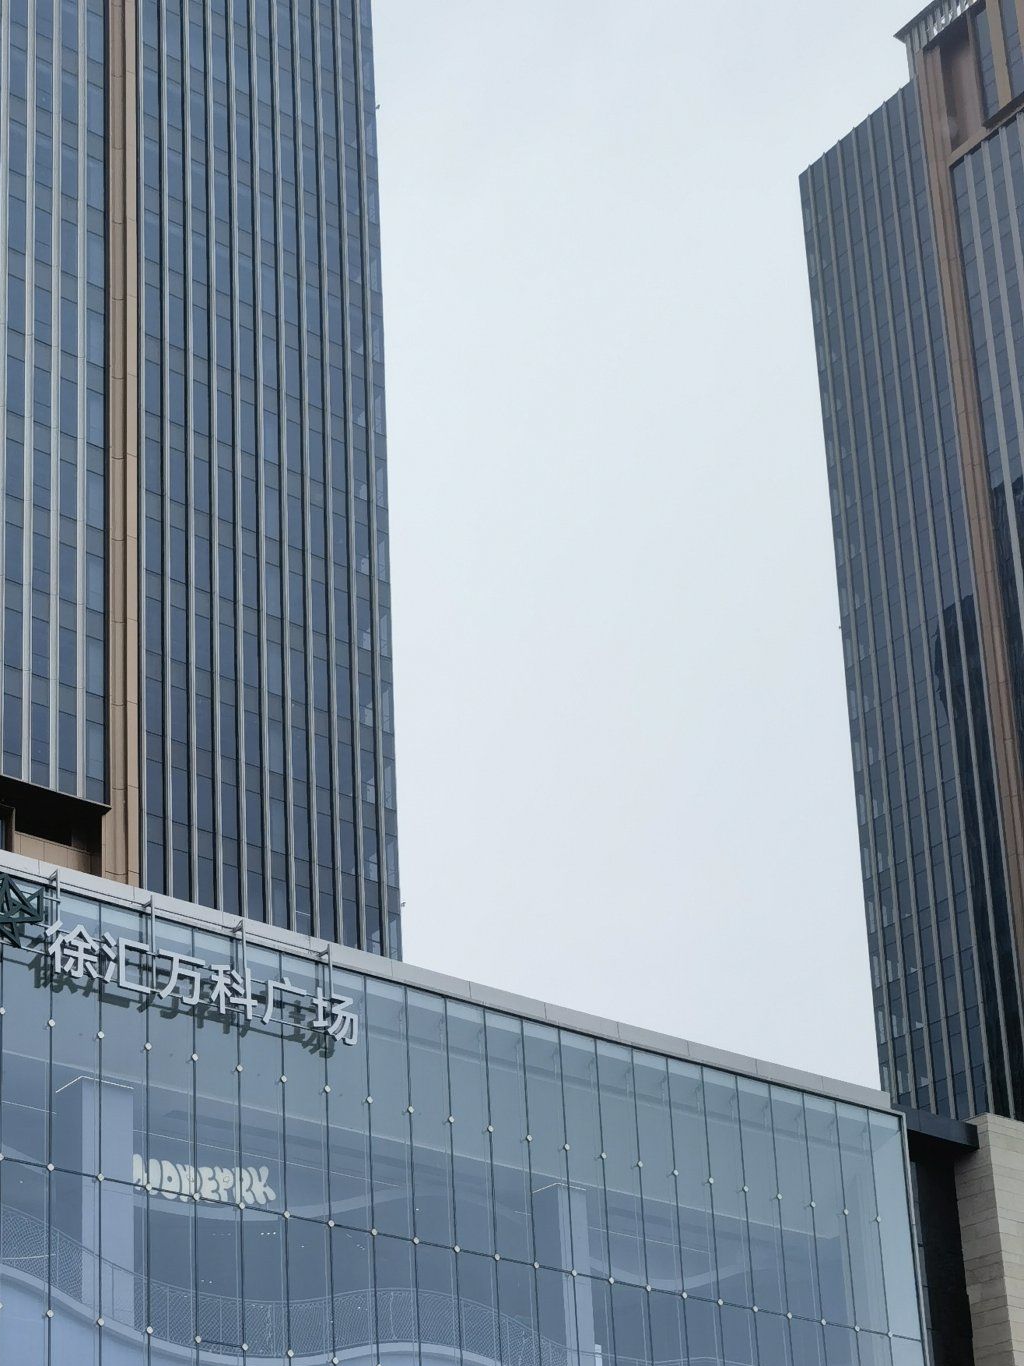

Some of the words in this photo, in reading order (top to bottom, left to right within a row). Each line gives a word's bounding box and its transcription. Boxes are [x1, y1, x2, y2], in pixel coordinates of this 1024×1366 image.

[45, 919, 359, 1046] 徐汇万科广场
